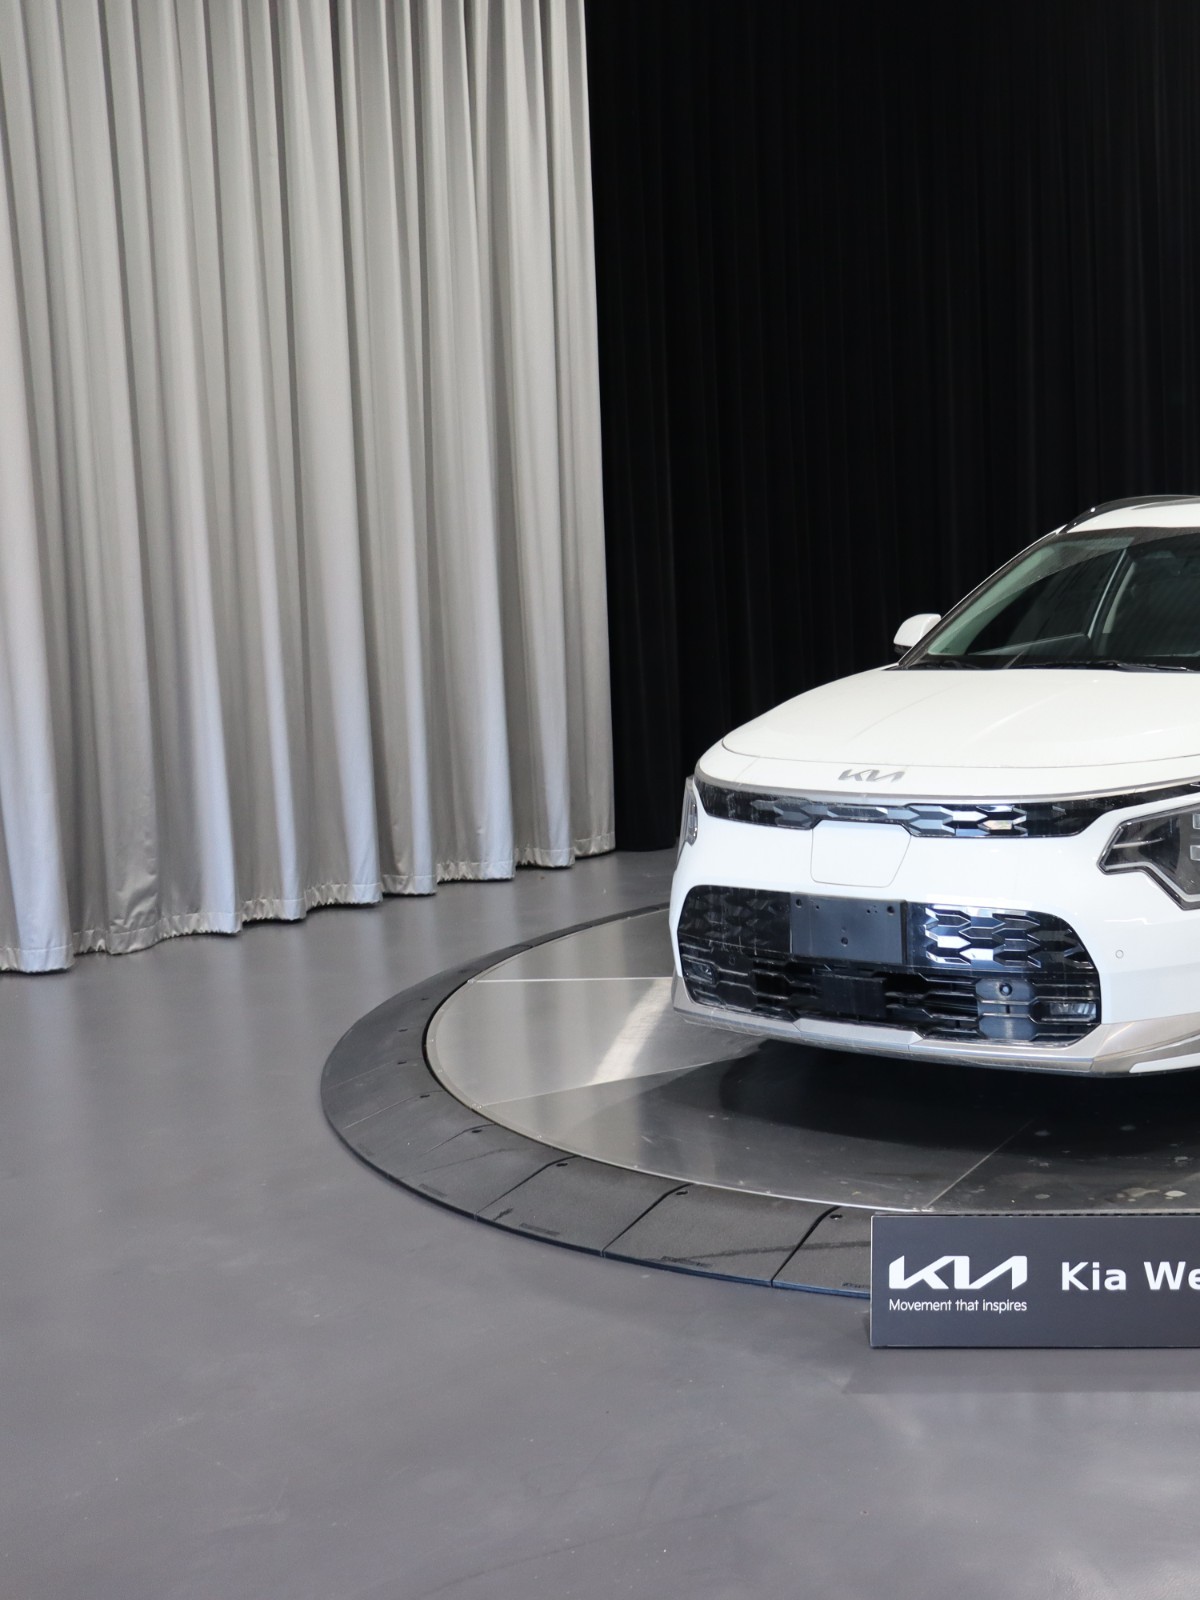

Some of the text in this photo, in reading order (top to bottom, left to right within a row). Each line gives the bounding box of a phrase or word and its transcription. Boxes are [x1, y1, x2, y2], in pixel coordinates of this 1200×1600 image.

[838, 769, 905, 782] KIA
[888, 1255, 1028, 1291] KIA
[1061, 1261, 1127, 1292] Kia
[888, 1298, 1028, 1315] Movement that inspires
